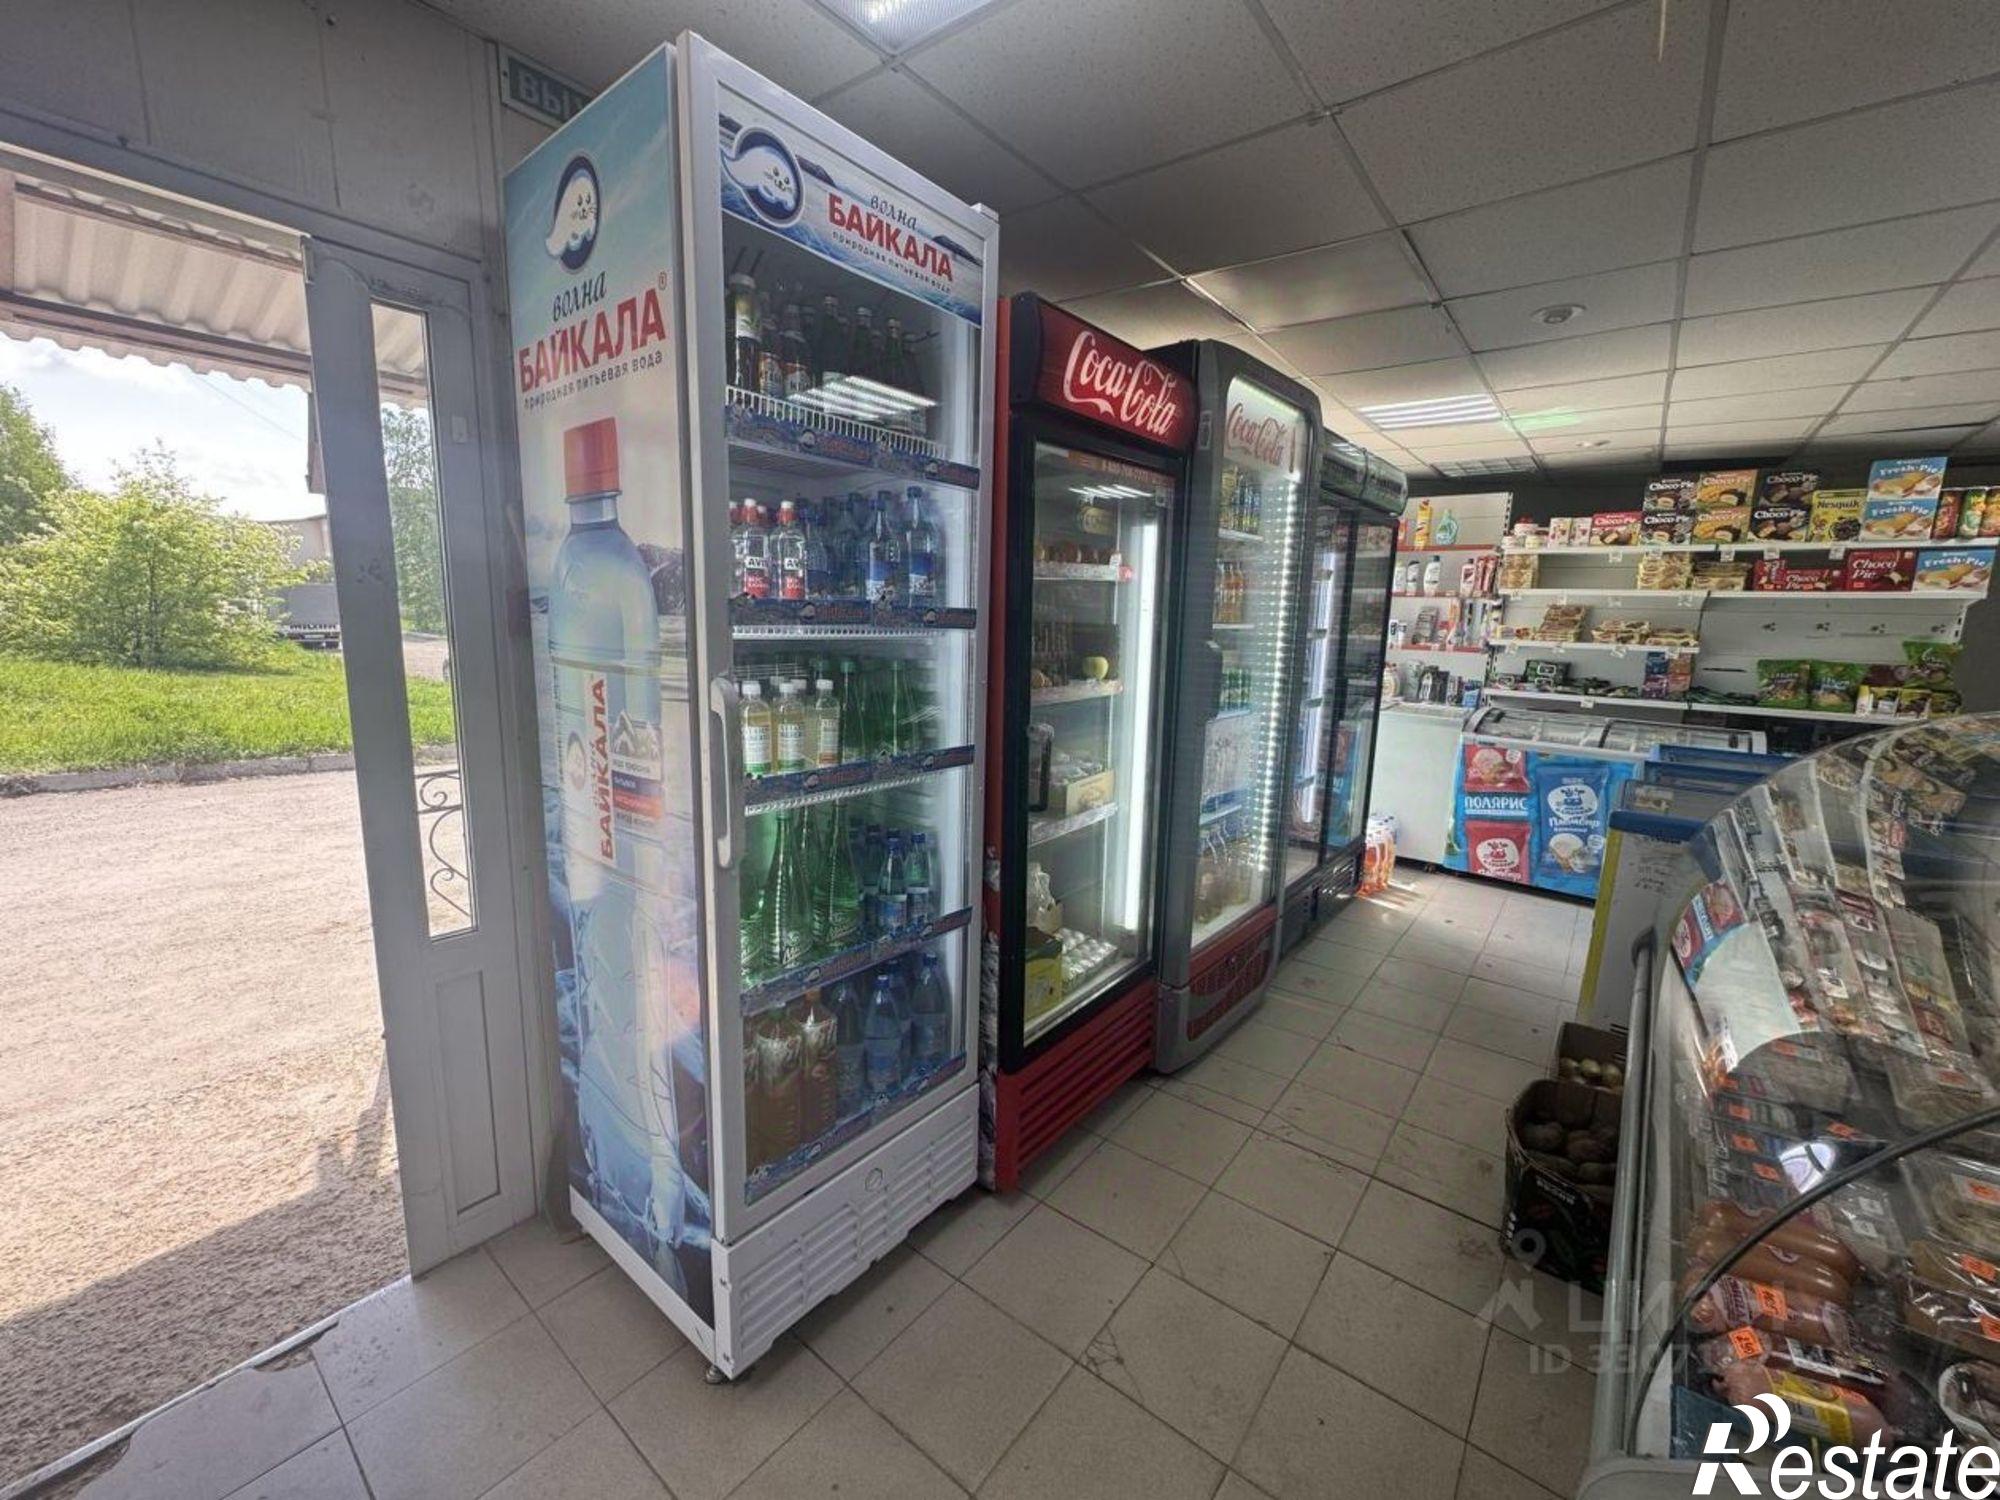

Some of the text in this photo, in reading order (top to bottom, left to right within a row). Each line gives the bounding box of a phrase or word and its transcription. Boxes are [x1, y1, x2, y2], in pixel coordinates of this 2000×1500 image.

[828, 192, 953, 282] БАЙКАЛА
[552, 270, 608, 322] волна
[518, 287, 667, 394] БАЙКАЛА
[631, 350, 664, 373] вода
[1063, 330, 1177, 435] Coca-Cola
[1226, 402, 1288, 467] Coca-Cola
[1852, 559, 1897, 569] Choco
[1852, 569, 1876, 580] Pie
[591, 677, 614, 861] БАЙКАЛА
[1464, 796, 1529, 811] ПОЛЯРИС
